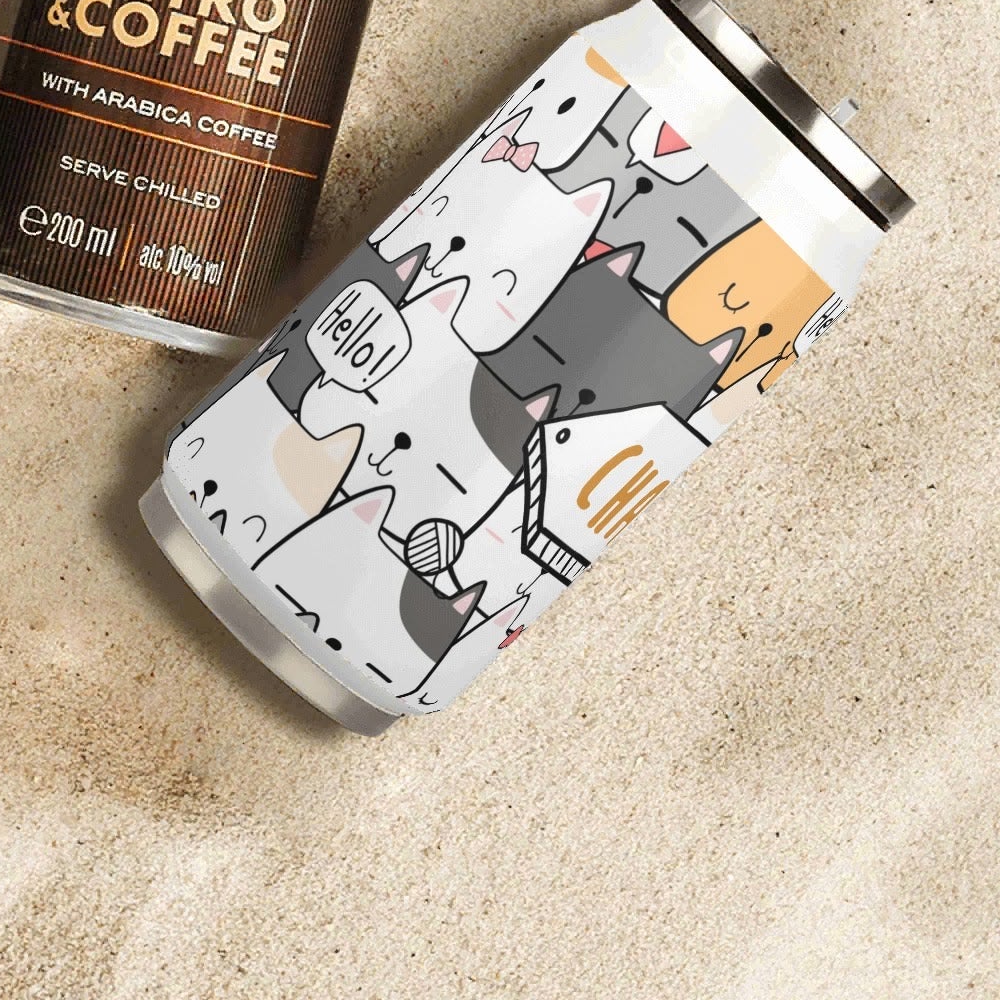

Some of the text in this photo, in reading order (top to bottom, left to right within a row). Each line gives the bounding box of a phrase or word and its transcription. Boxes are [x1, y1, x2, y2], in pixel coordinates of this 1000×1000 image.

[42, 71, 278, 150] WITH ARABICA COFFEE
[60, 155, 221, 210] SERVE CHILLED
[85, 226, 118, 257] ml
[166, 244, 201, 281] 10%
[203, 259, 225, 286] vol
[317, 289, 396, 383] Hello!
